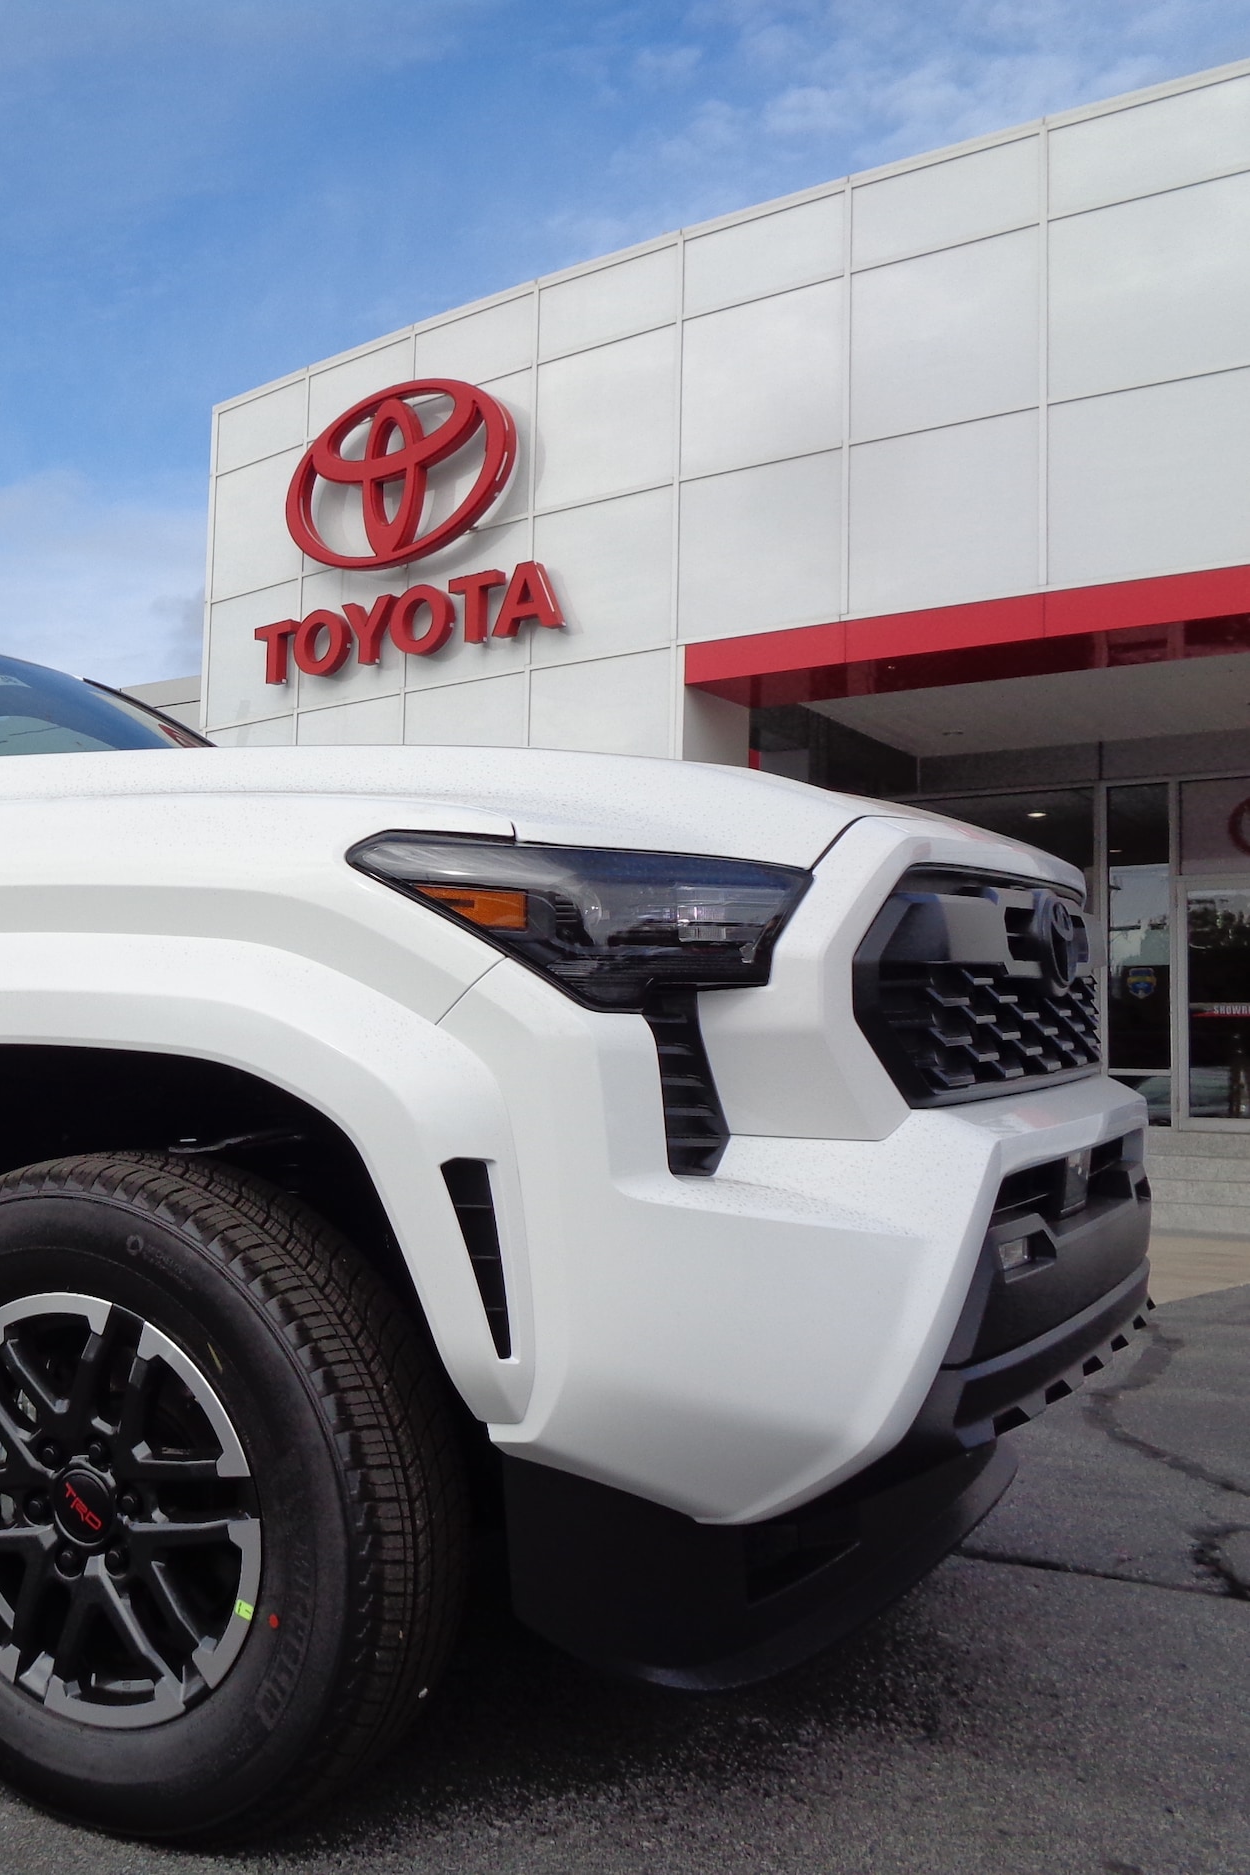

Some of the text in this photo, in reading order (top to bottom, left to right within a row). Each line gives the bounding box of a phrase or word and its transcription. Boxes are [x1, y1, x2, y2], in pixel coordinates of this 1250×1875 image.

[254, 560, 566, 685] TOYOTA
[1213, 1003, 1250, 1015] SHOWR
[65, 1482, 102, 1531] TRD
